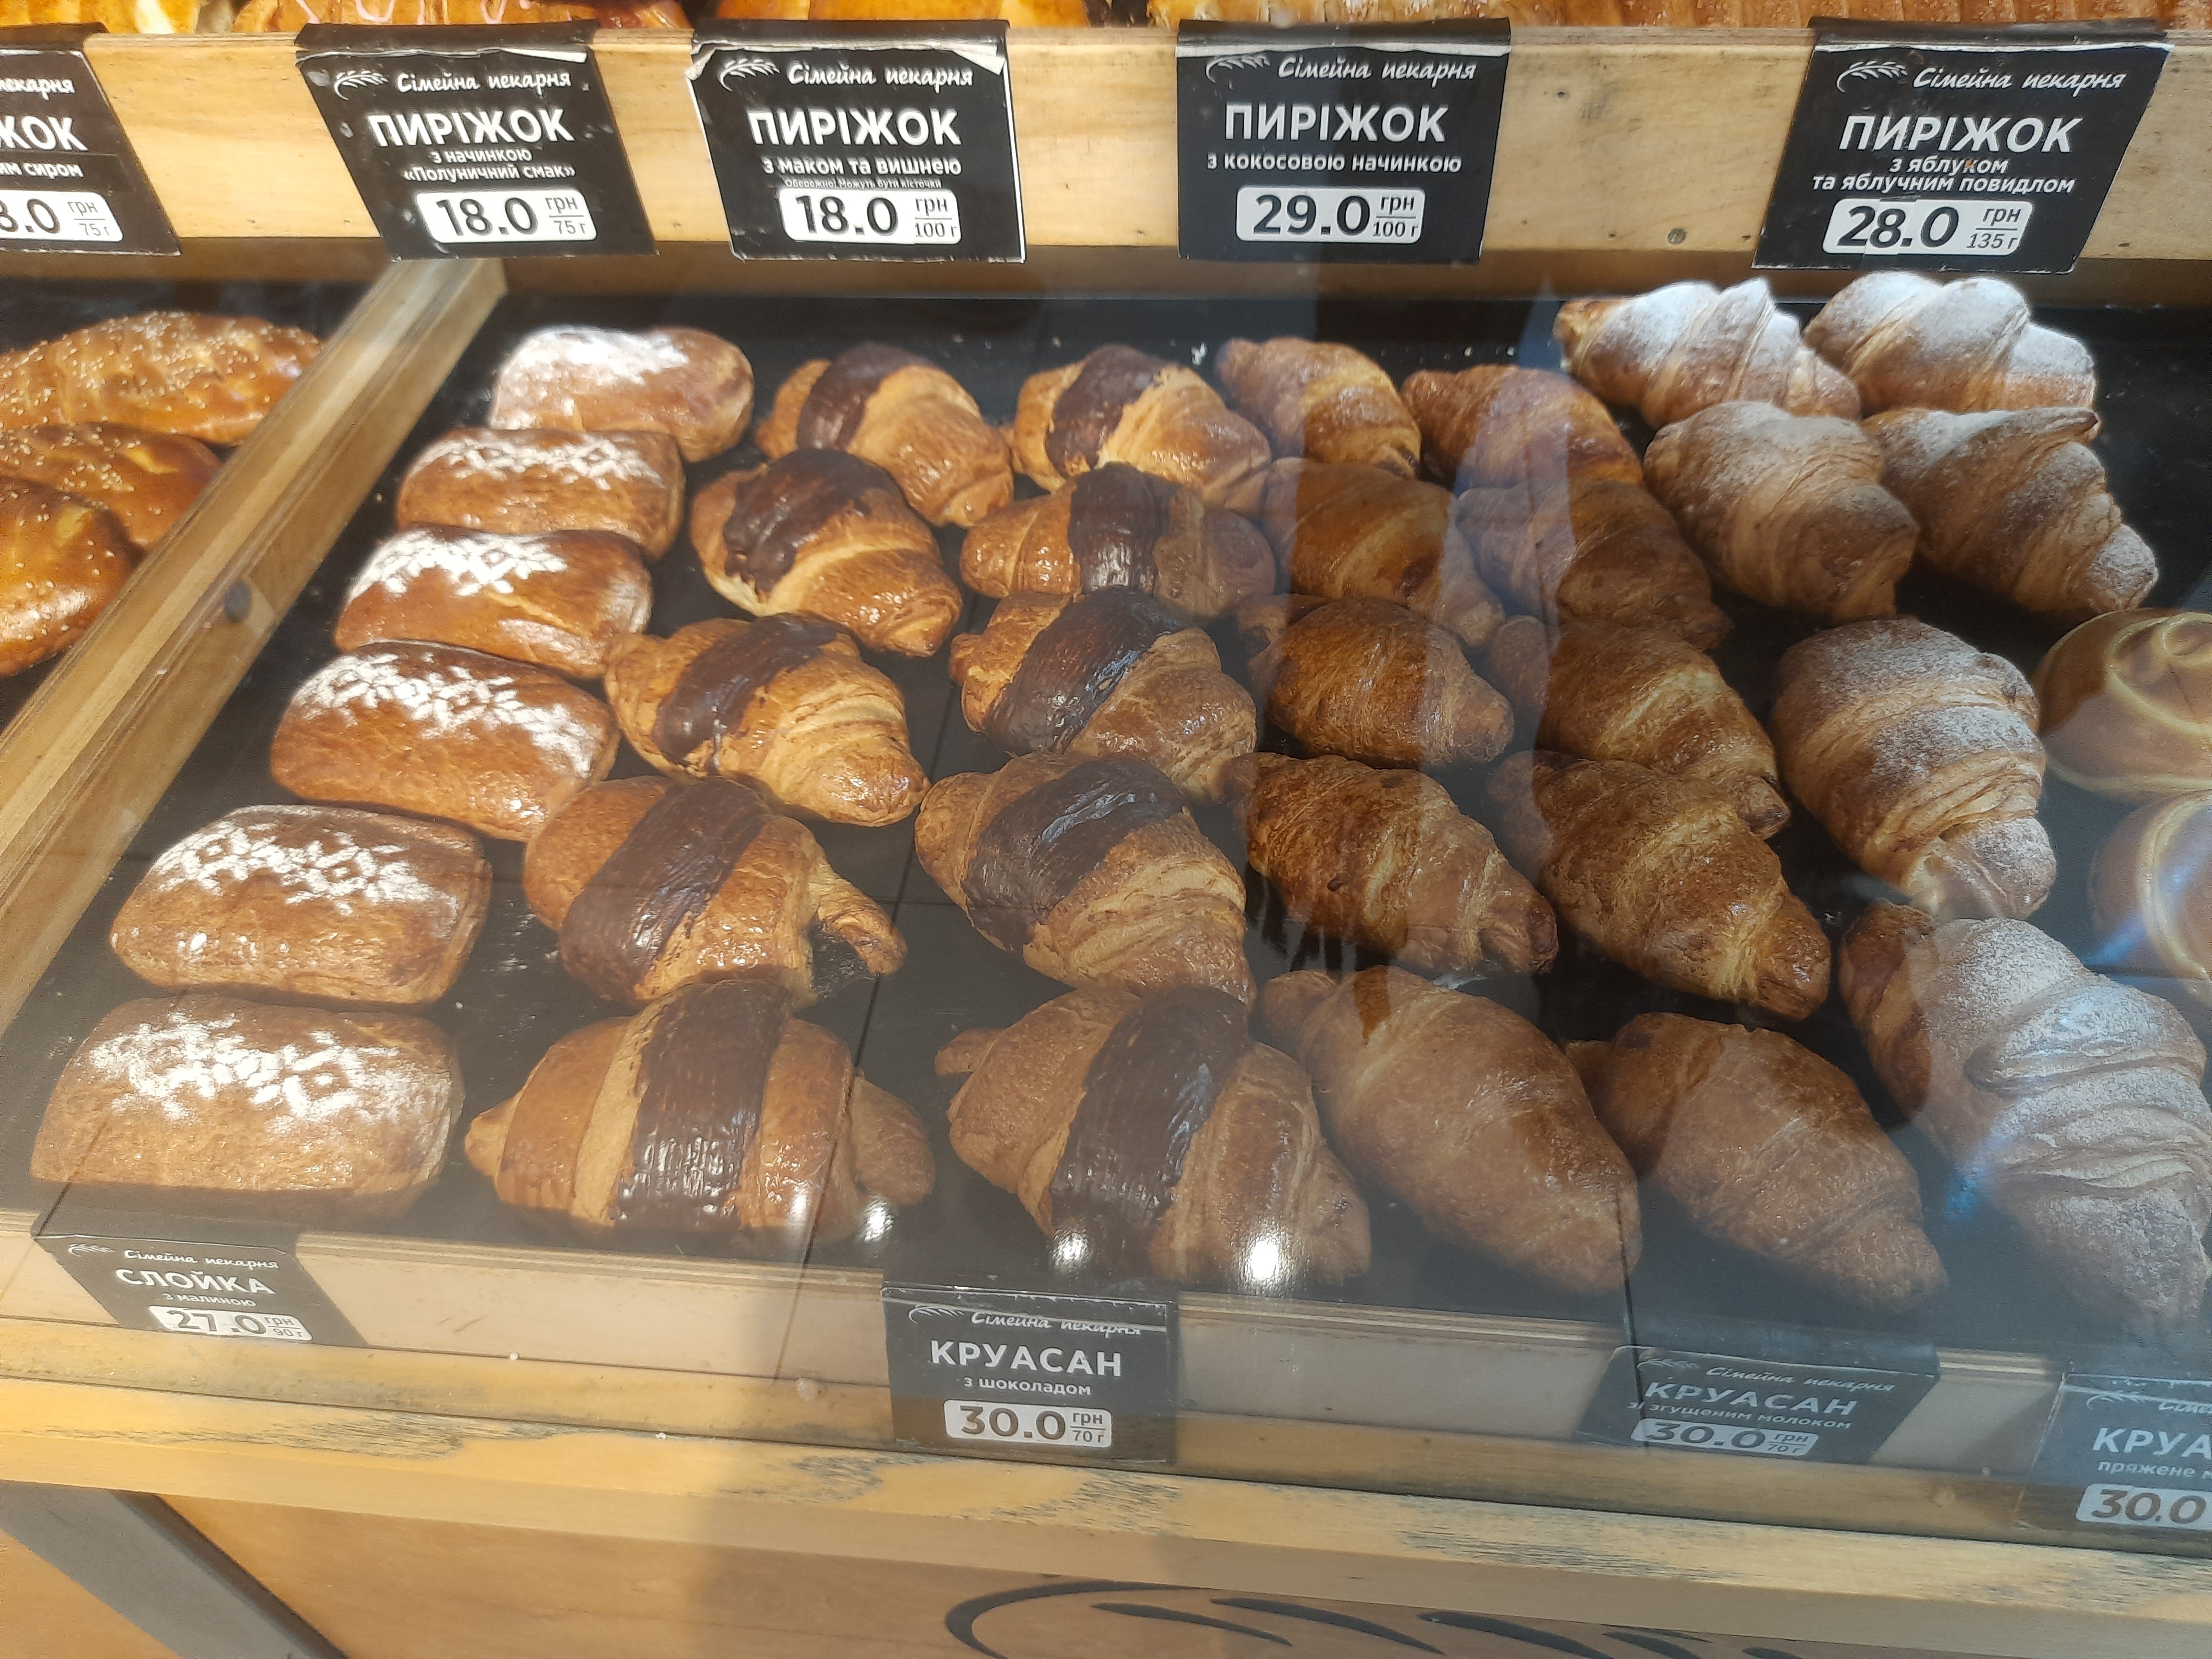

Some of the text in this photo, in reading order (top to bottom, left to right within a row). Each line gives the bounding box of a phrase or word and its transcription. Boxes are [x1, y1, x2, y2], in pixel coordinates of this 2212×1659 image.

[787, 62, 973, 93] Сімейна пекарня
[1278, 55, 1477, 88] Сімейна пекарня
[1913, 67, 2127, 97] Сімейна пекарня
[397, 71, 572, 95] Сімейна пекарня
[366, 108, 575, 147] ПИРІЖОК
[746, 107, 962, 145] ПИРІЖОК
[1225, 103, 1449, 142] ПИРІЖОК
[1839, 115, 2084, 153] ПИРІЖОК
[431, 148, 533, 164] з начинкою
[763, 157, 962, 176] з маком та вишнею
[1206, 152, 1462, 173] з кокосовою начинкою
[1888, 156, 2009, 175] з яблуком
[23, 162, 84, 180] сиром
[403, 163, 576, 183] «Полуничний смак»
[1813, 173, 2077, 195] та яблучним повидлом
[67, 201, 99, 216] грн
[545, 196, 578, 213] грн
[795, 195, 898, 235] 18.0
[915, 196, 949, 216] грн
[1253, 194, 1371, 235] 29.0
[1380, 196, 1415, 214] грн
[1982, 206, 2022, 224] грн
[436, 197, 539, 236] 18.0
[553, 220, 576, 235] 75
[1836, 206, 1959, 248] 28.0
[915, 221, 945, 238] 100
[1372, 221, 1405, 237] 100
[1966, 233, 2003, 249] 135
[123, 1249, 279, 1271] Сімейна пекарня
[115, 1268, 276, 1294] СЛОЙКА
[163, 1292, 256, 1307] з малиною
[166, 1309, 267, 1335] 27.0
[265, 1316, 295, 1327] грн
[930, 1340, 1122, 1377] КРУАСАН
[963, 1376, 1092, 1396] з шоколадом
[1705, 1366, 1895, 1393] Сімейна пекарня
[1644, 1382, 1859, 1416] КРУАСАН
[960, 1405, 1066, 1440] 30.0
[1072, 1412, 1103, 1426] грн
[1649, 1403, 1752, 1420] згущеним
[1757, 1413, 1852, 1429] молоком
[1647, 1422, 1766, 1449] 30.0
[1773, 1433, 1809, 1444] грн
[2098, 1460, 2196, 1478] пряжене
[2091, 1489, 2207, 1524] 30.0
